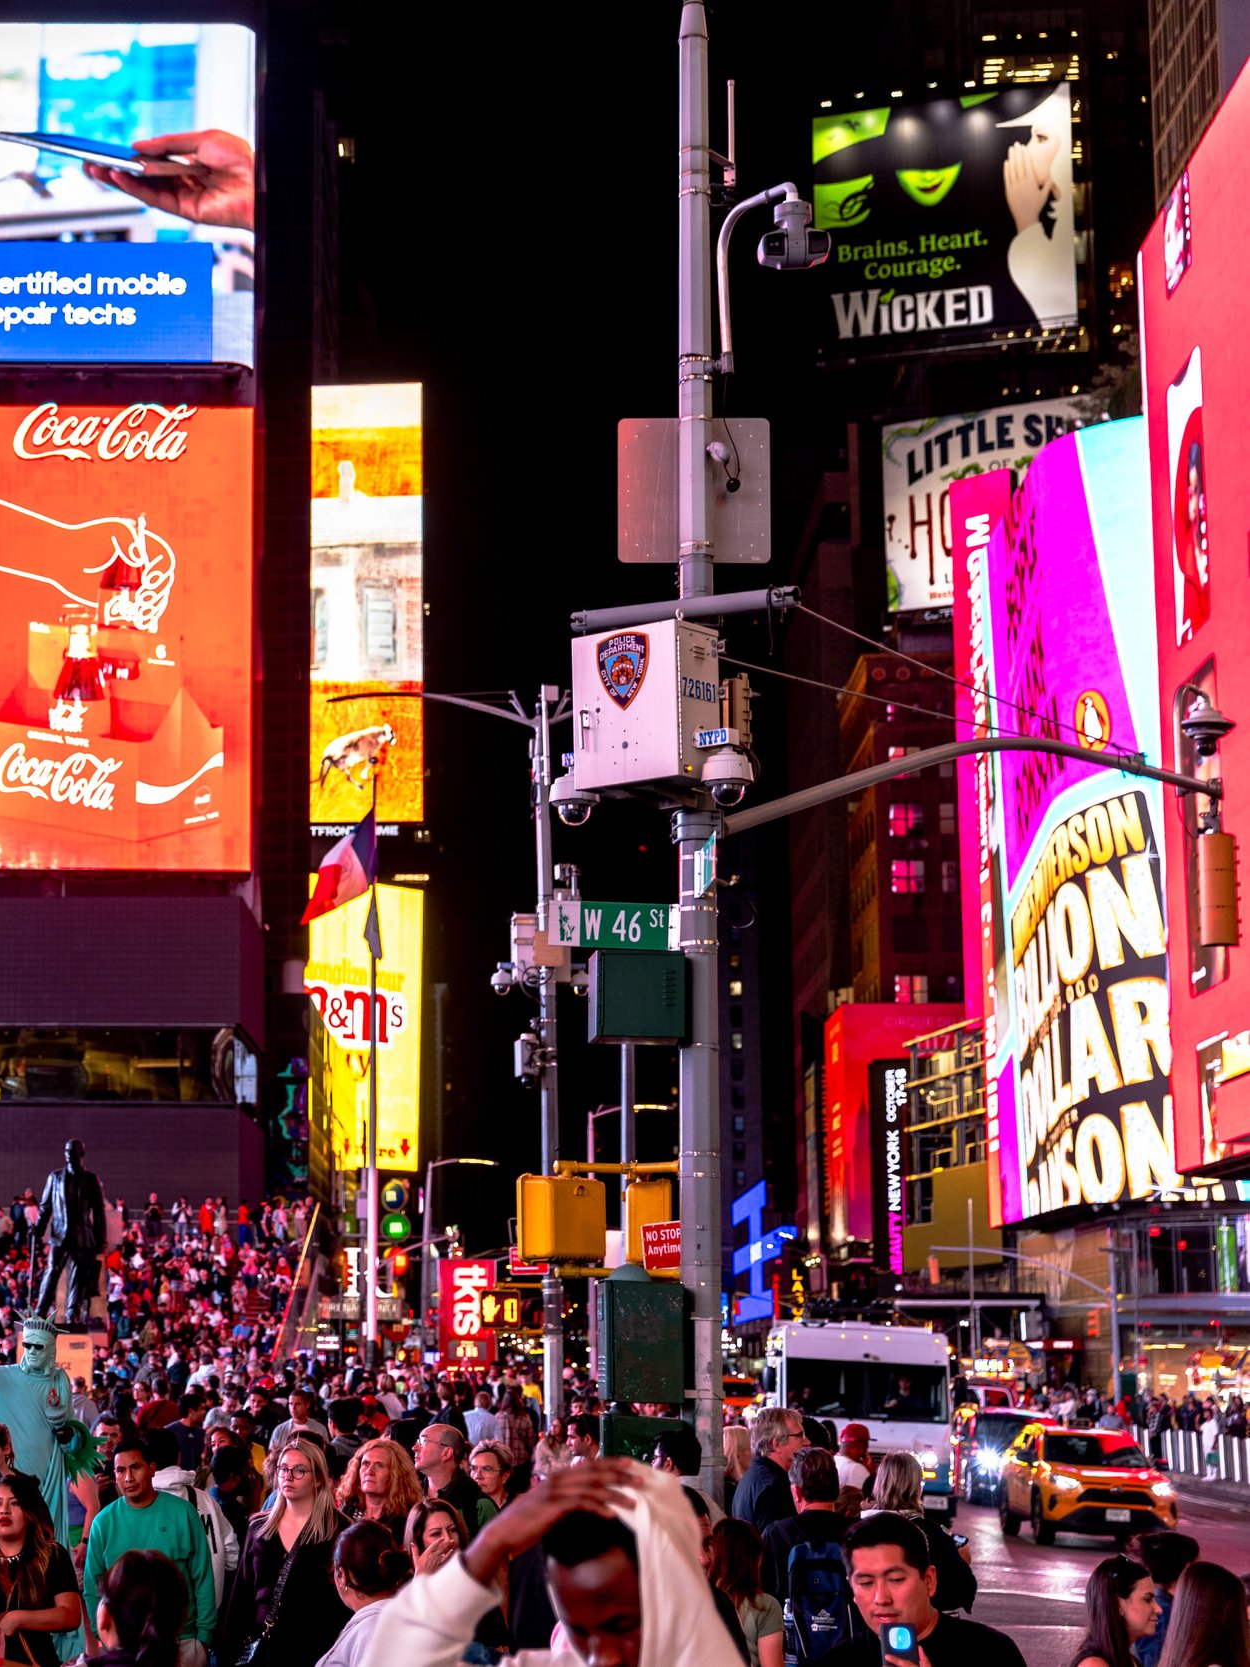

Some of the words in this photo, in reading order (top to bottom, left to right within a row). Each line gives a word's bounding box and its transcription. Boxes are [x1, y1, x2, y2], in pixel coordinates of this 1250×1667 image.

[837, 240, 914, 263] Brains.
[919, 229, 989, 252] Heart.
[864, 255, 962, 280] Courage.
[97, 272, 187, 295] mobile
[62, 302, 137, 326] techs
[12, 401, 198, 461] Coca-Cola
[907, 414, 1014, 487] LITTLE
[599, 644, 645, 662] DEPARTMENT
[609, 635, 636, 647] POLICE
[600, 669, 611, 687] CITY
[626, 682, 638, 698] NEW
[636, 658, 646, 680] YORK
[682, 677, 717, 703] 726161
[698, 729, 727, 746] NYPD
[584, 909, 602, 940] W
[612, 910, 642, 942] 46
[649, 908, 665, 928] St
[646, 1230, 658, 1242] NO
[453, 1264, 488, 1336] tkts
